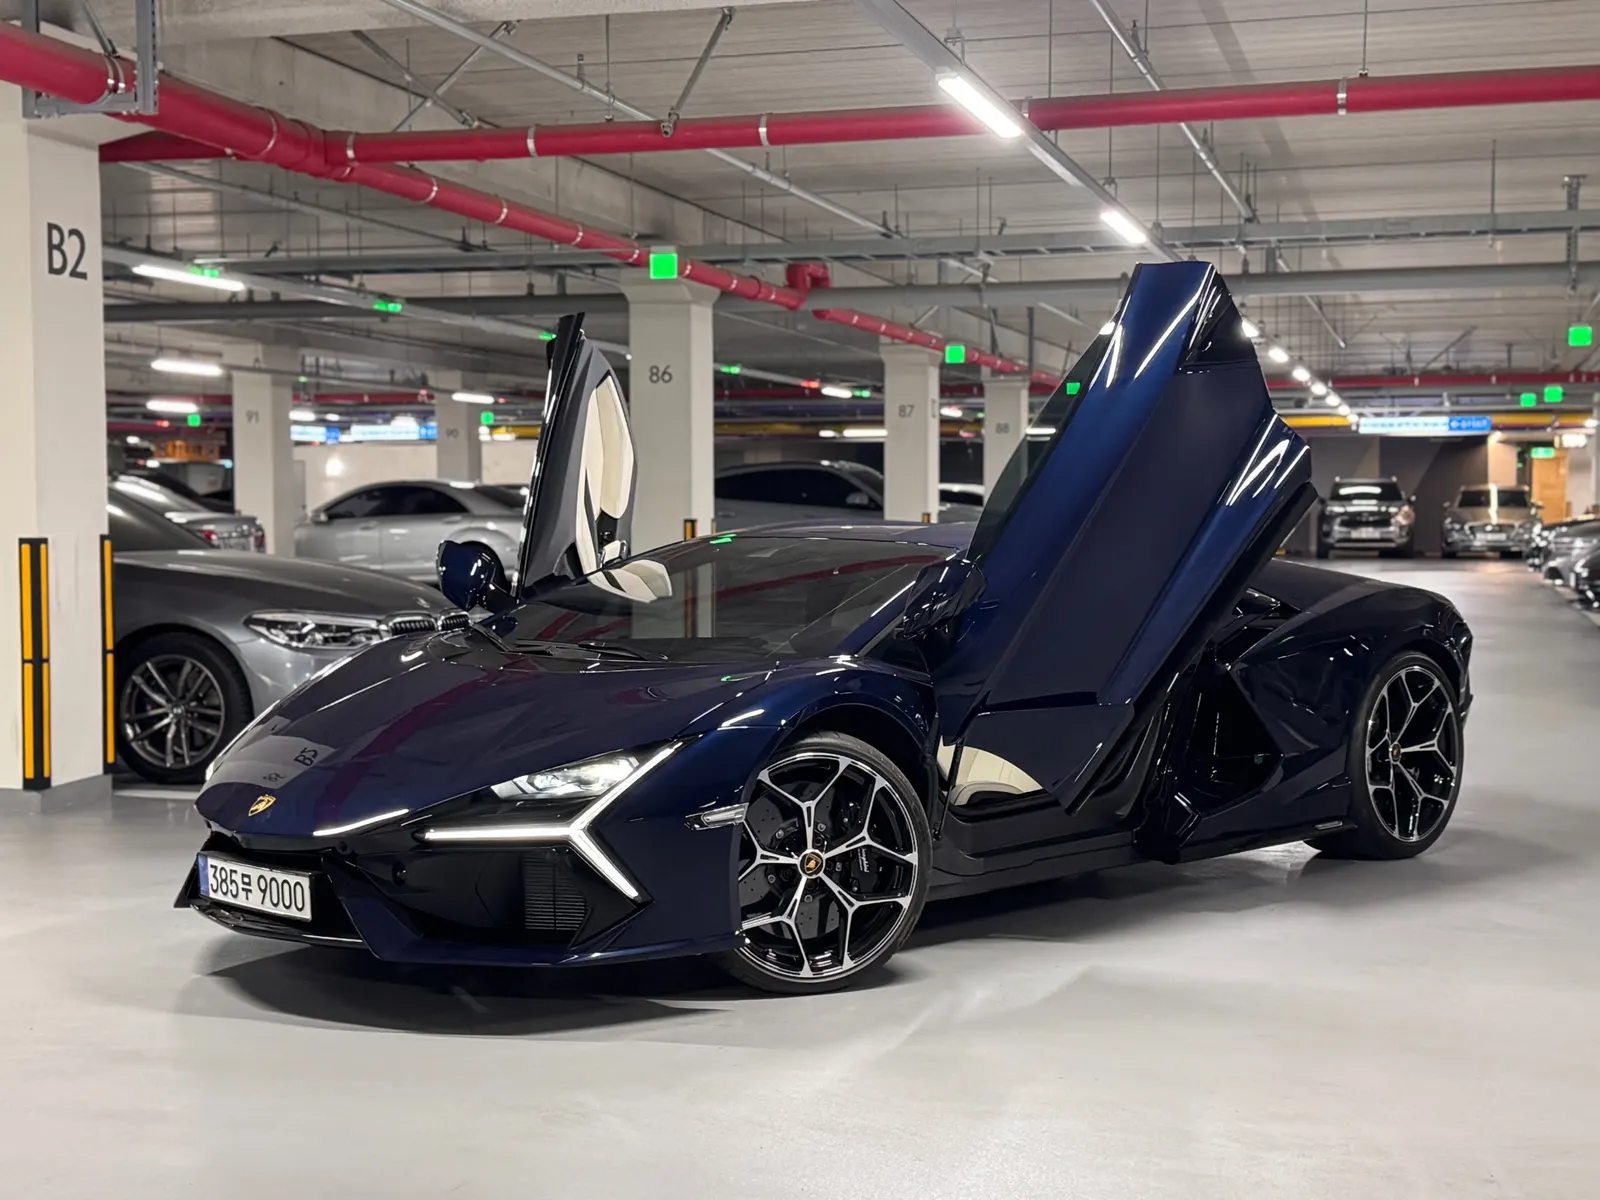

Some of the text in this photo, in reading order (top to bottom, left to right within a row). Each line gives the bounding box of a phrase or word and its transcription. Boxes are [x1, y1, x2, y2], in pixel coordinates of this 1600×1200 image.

[47, 221, 88, 280] B2
[649, 364, 673, 383] 86
[246, 410, 260, 424] 91
[898, 404, 915, 418] 87
[210, 864, 305, 912] 385무 9000
